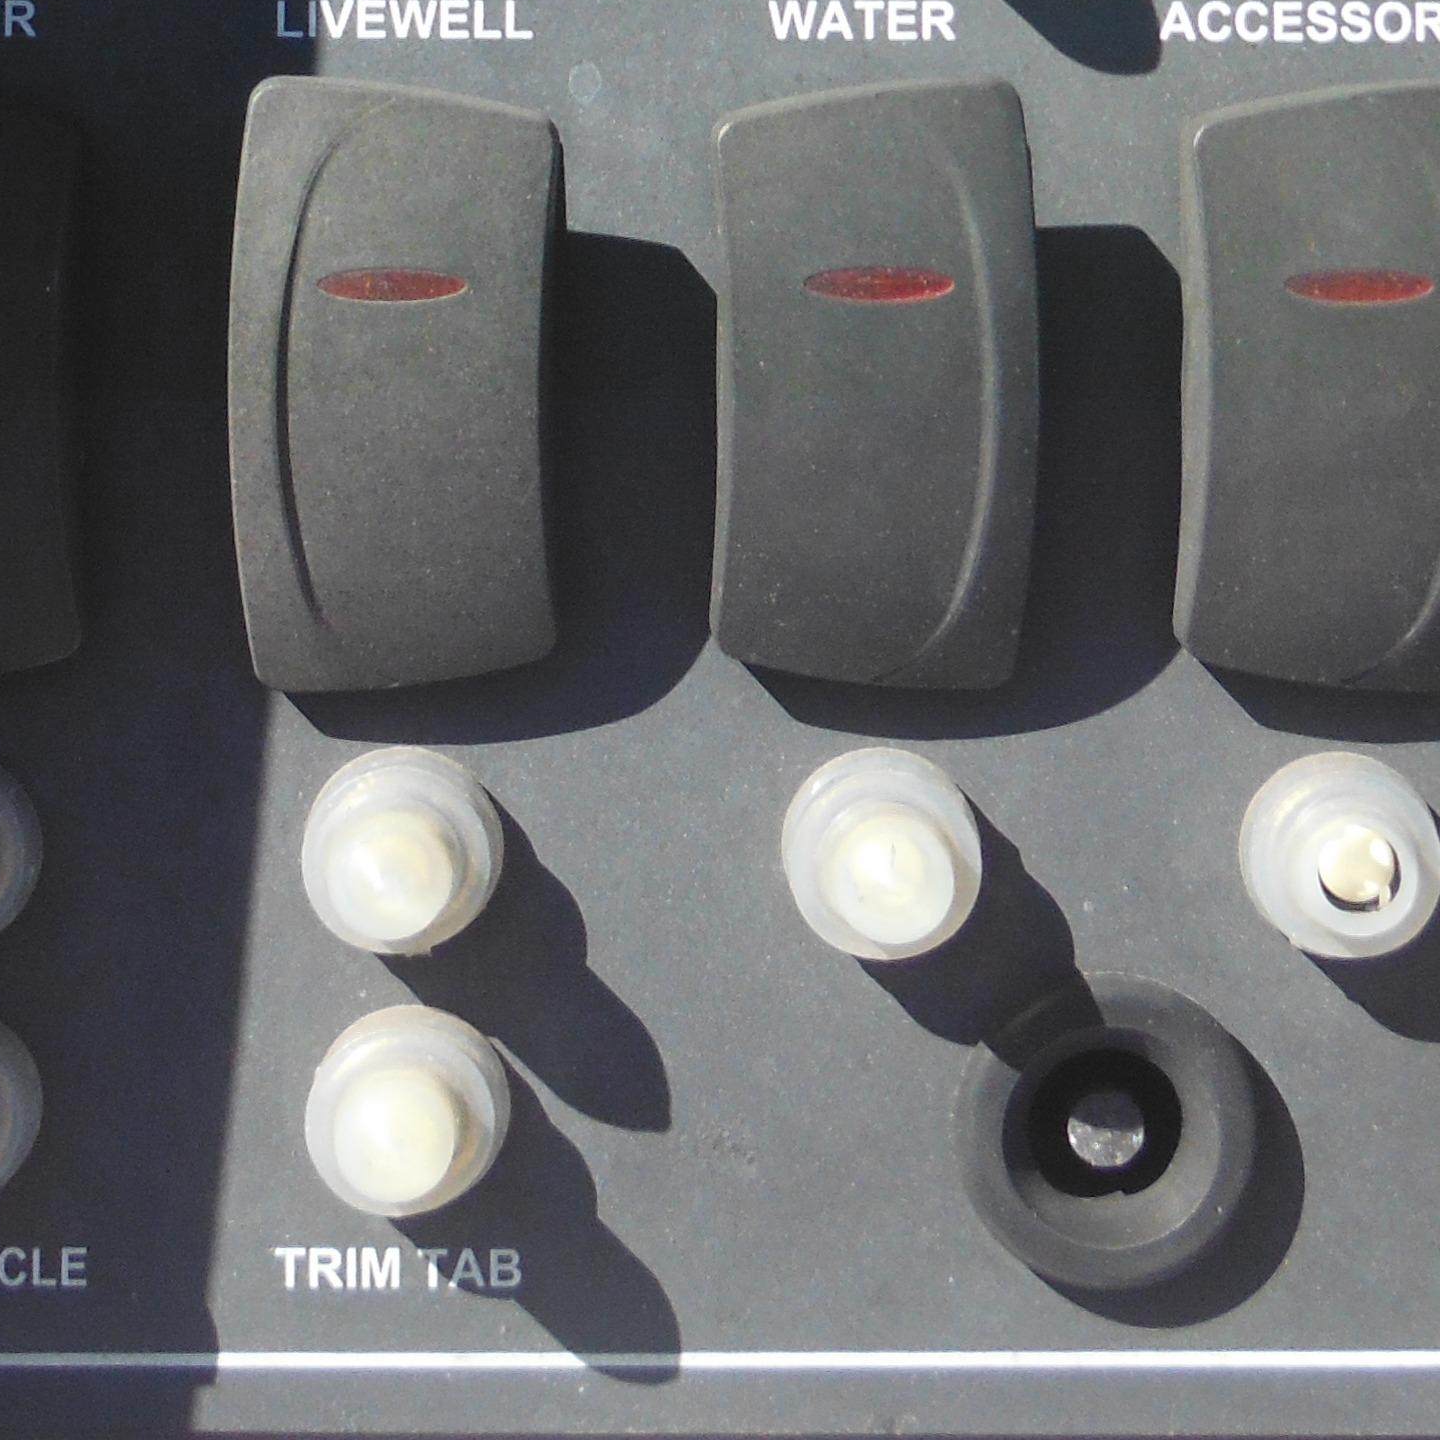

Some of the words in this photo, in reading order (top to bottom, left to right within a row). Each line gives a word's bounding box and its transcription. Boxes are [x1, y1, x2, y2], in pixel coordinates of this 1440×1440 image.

[768, 0, 957, 42] WATER
[274, 1246, 401, 1290] TRIM
[416, 1247, 523, 1290] TAB
